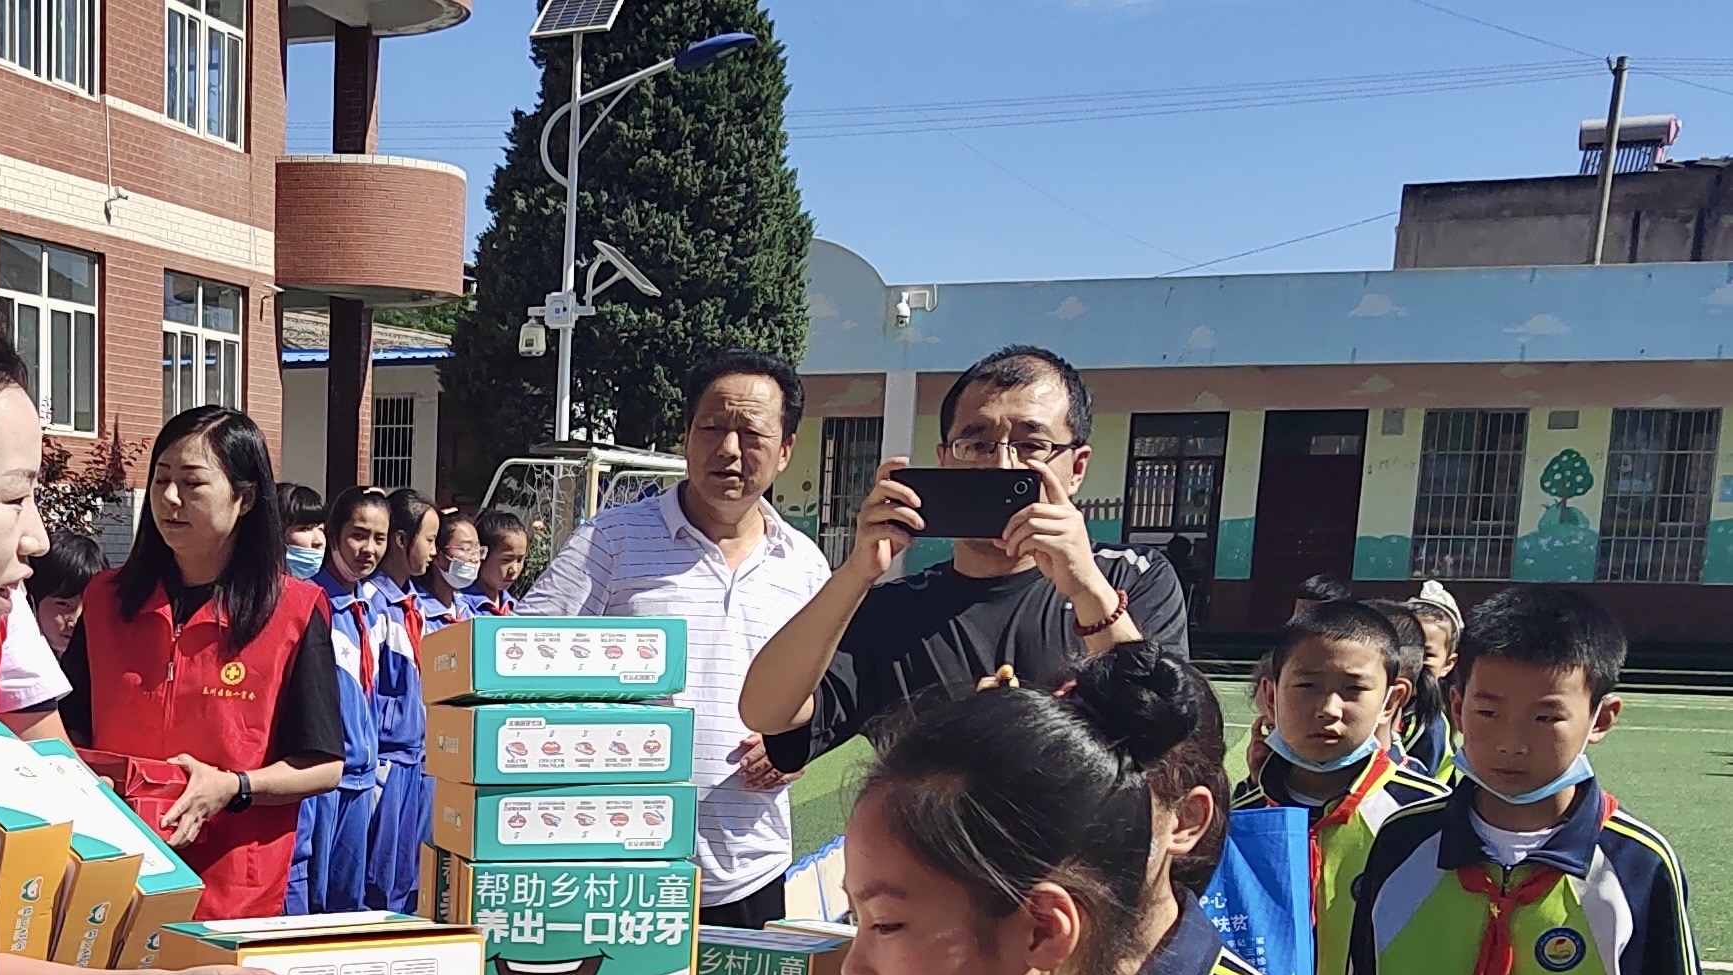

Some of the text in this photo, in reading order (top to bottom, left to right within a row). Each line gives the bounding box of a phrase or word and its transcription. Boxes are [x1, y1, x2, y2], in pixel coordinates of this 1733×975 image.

[476, 873, 691, 908] 帮助乡村儿童
[475, 909, 690, 945] 养出一口好牙
